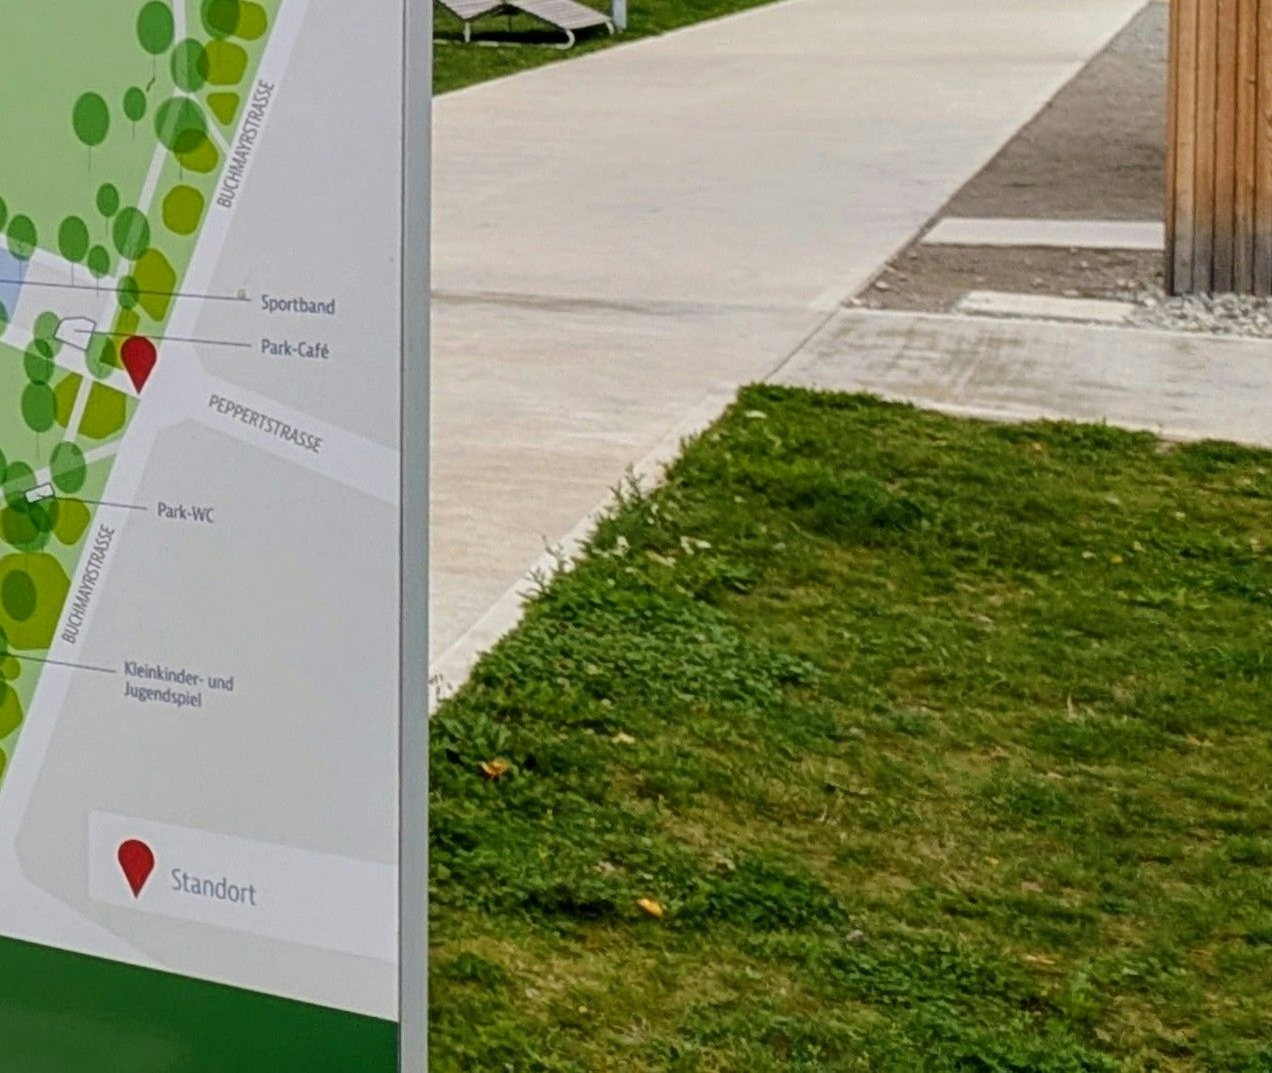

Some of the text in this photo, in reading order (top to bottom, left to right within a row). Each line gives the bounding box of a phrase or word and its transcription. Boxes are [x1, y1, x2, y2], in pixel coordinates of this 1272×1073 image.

[217, 79, 275, 208] BUCHMAYRSTRASSE
[261, 294, 336, 317] Sportband
[261, 337, 330, 360] Park-Café
[208, 394, 324, 454] PEPPERTSTRASSE
[157, 502, 215, 524] Park-WC
[61, 524, 115, 645] BUCHMAYRSTRASSE
[124, 660, 234, 692] Kleinkinder- und
[124, 682, 203, 709] Jugendspiel
[170, 868, 257, 907] Standort
